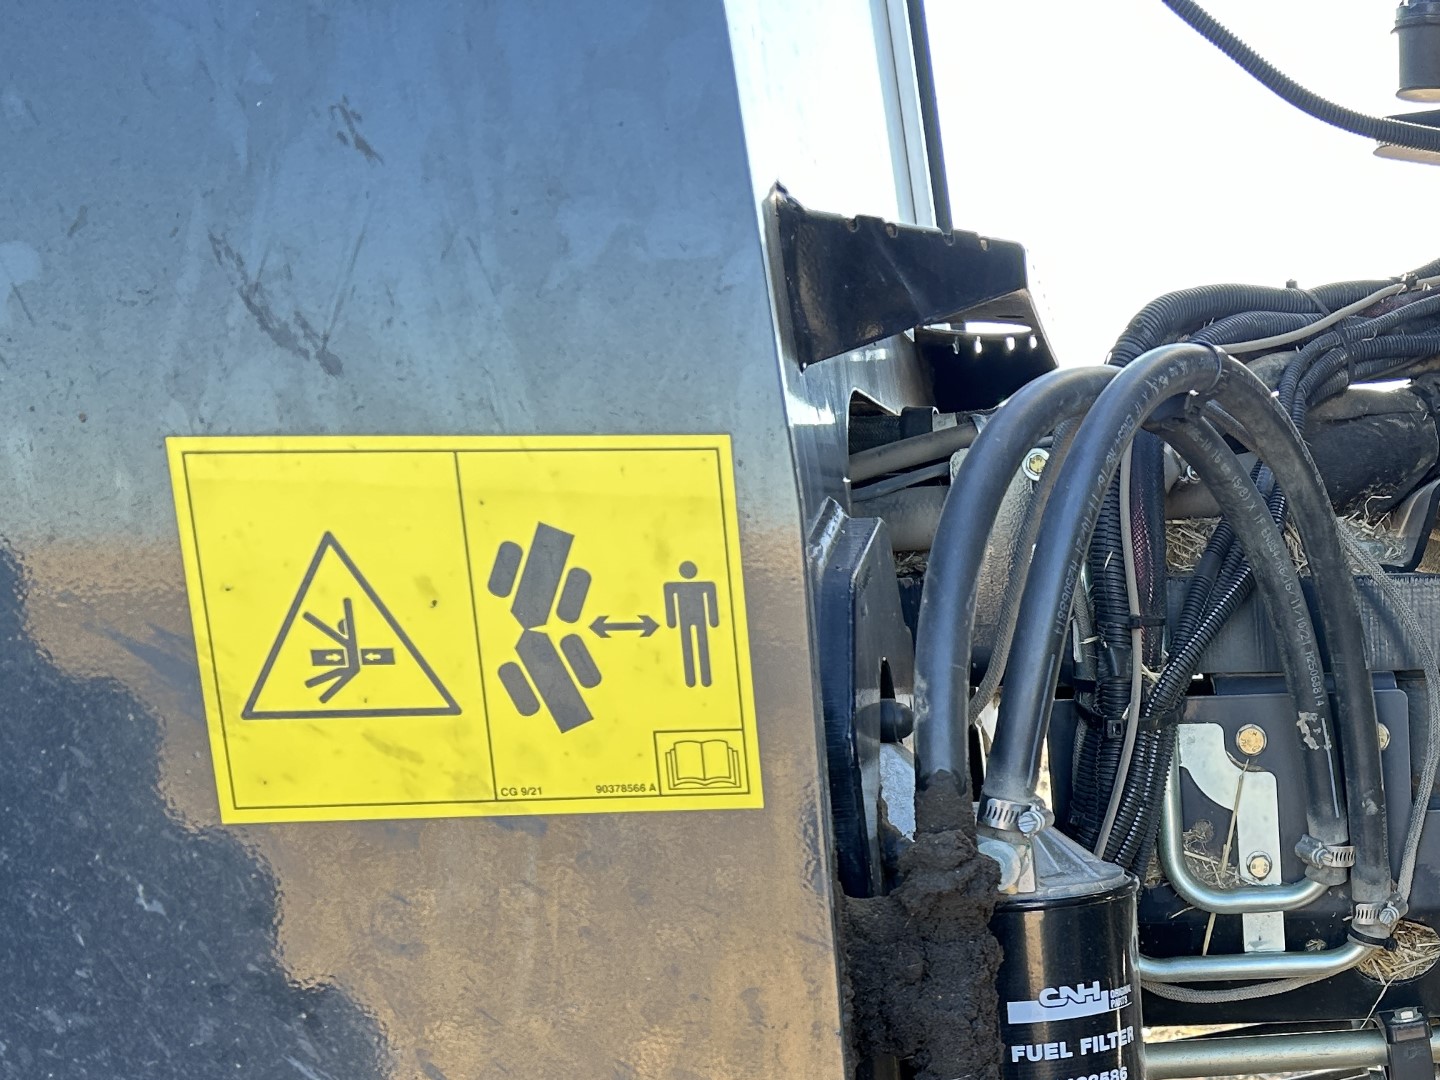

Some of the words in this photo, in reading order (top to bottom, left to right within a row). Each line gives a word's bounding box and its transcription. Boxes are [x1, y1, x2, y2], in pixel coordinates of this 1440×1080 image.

[500, 787, 518, 797] CG
[521, 786, 543, 796] 9/21
[595, 784, 646, 794] 90378566
[649, 783, 657, 792] A
[1039, 980, 1100, 1008] CNH
[1110, 994, 1129, 1009] PARTS
[1011, 1041, 1074, 1063] FUEL
[1080, 1025, 1135, 1056] FILTER
